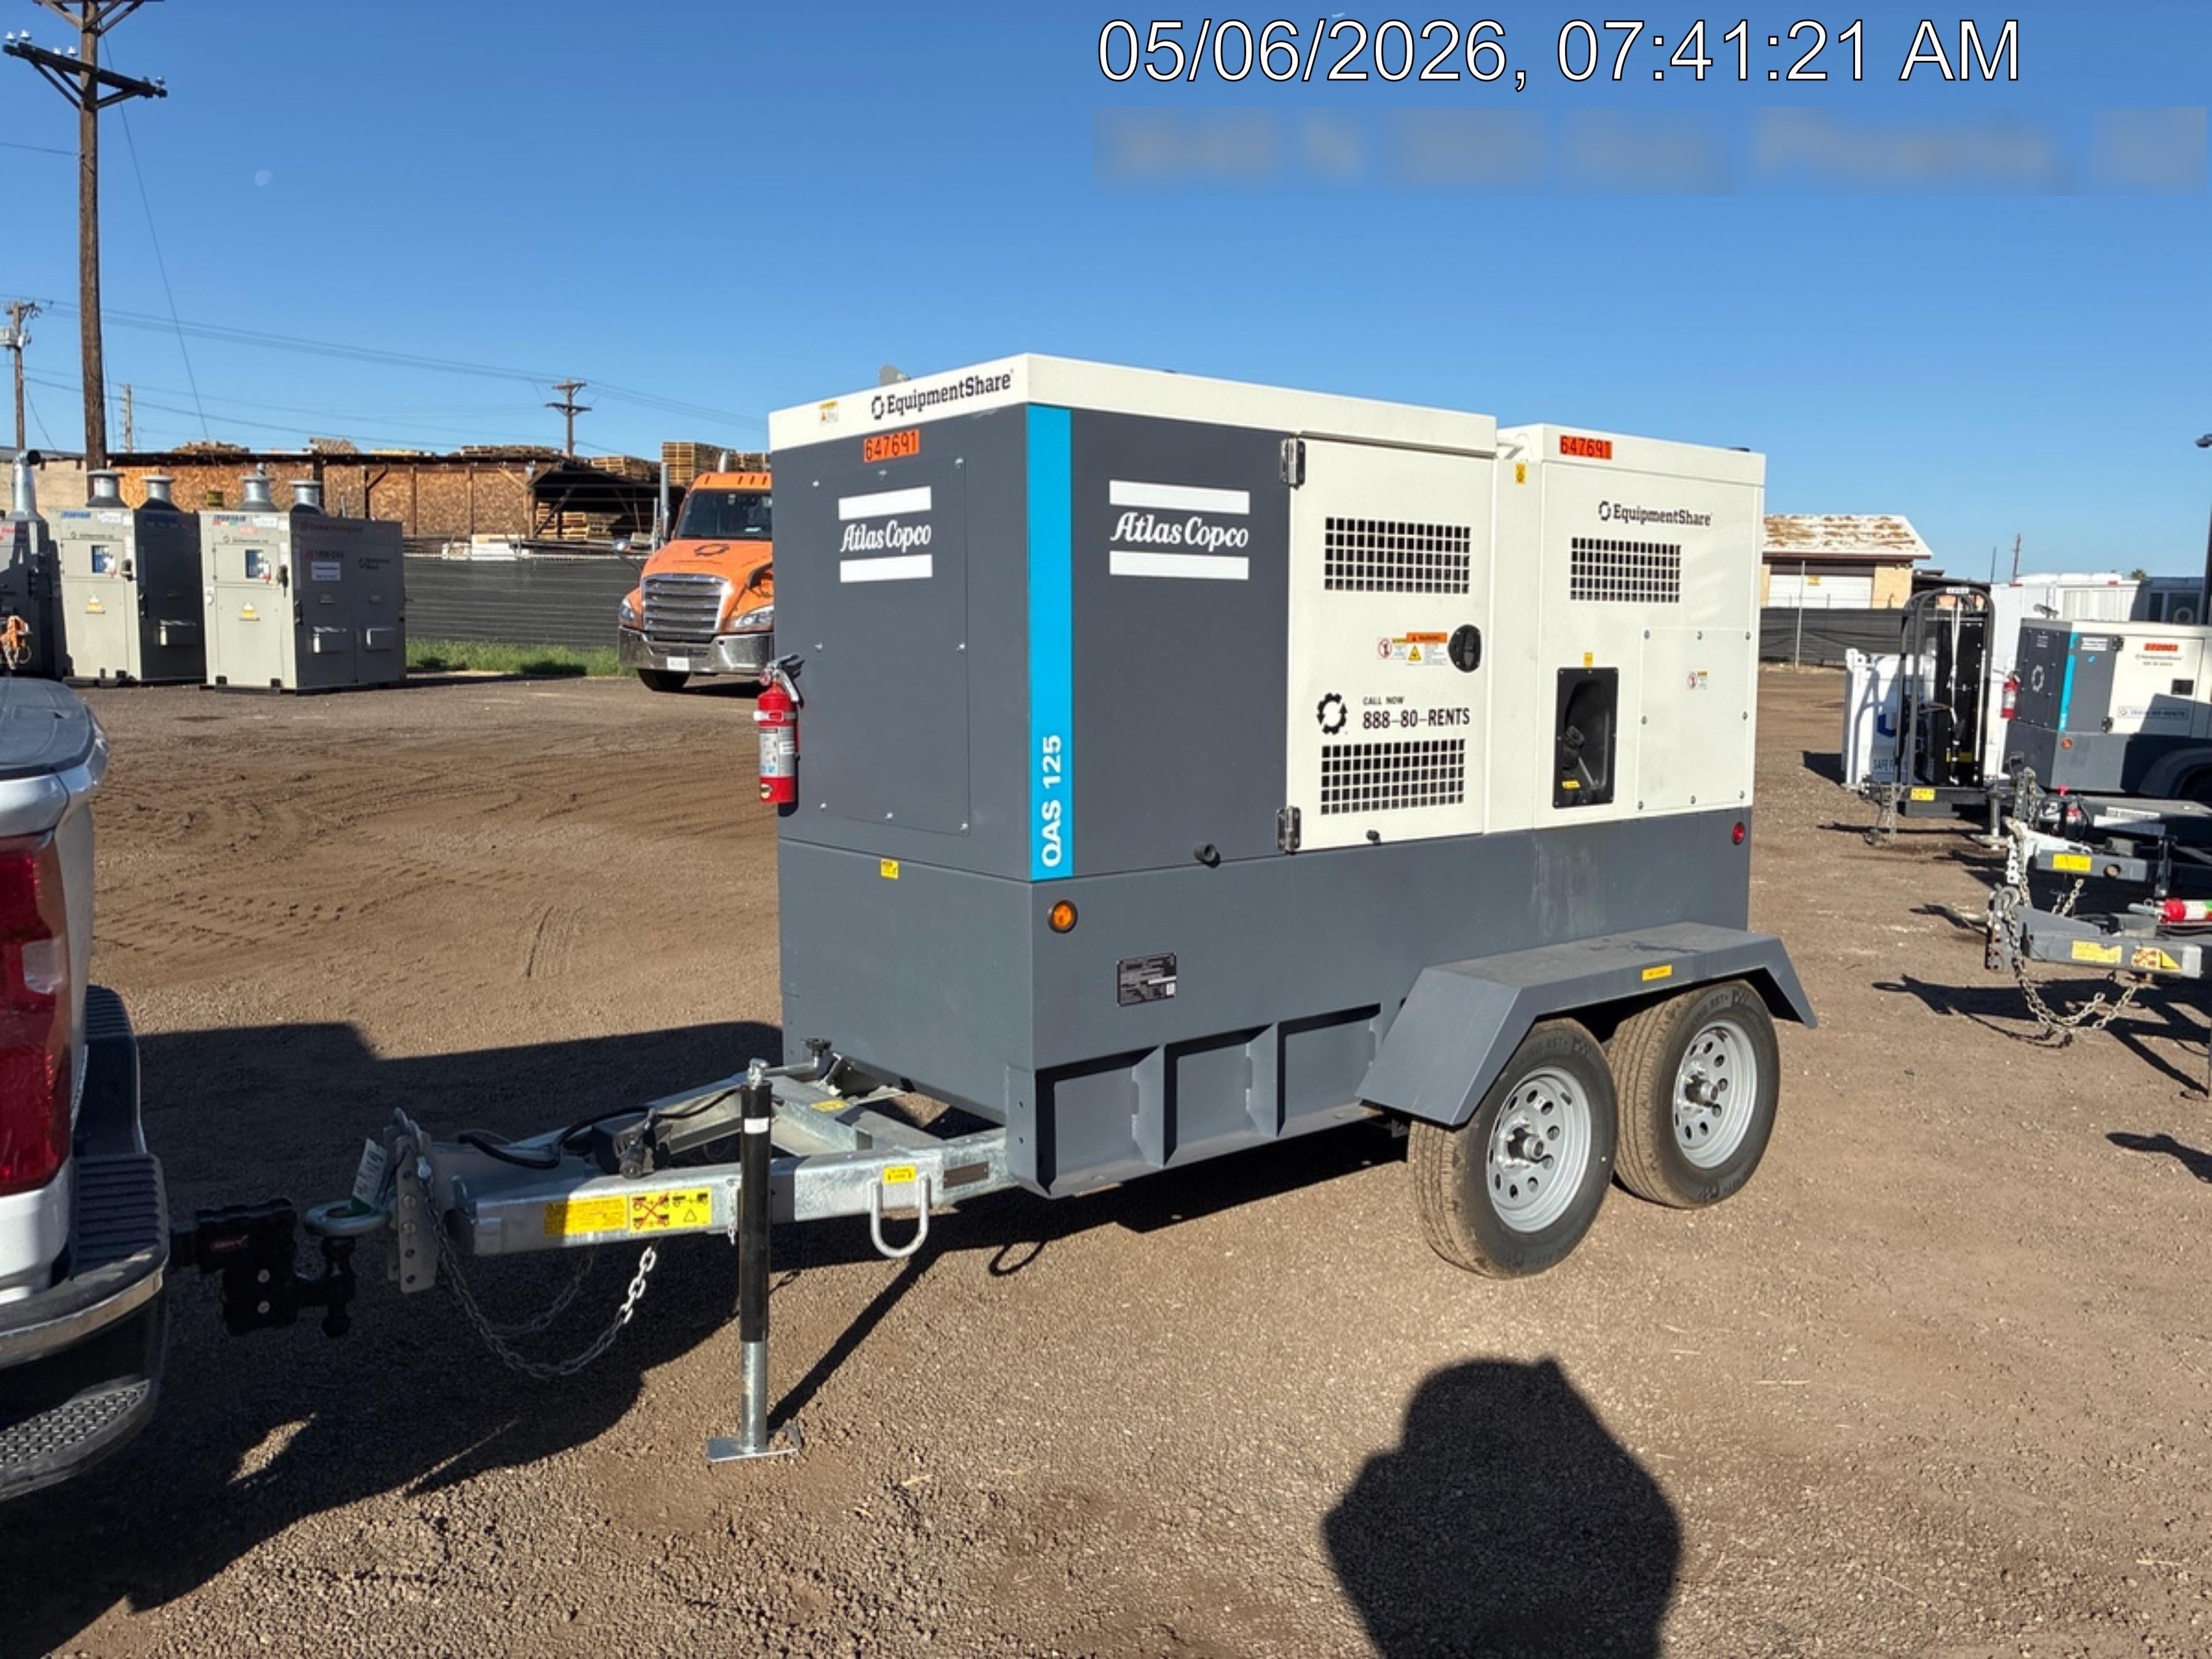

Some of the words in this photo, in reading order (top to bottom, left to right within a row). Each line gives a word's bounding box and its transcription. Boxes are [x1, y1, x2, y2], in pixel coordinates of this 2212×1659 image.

[886, 373, 1011, 416] EquipmentShare
[865, 431, 917, 461] 647691
[1559, 435, 1612, 459] 647691
[1613, 503, 1712, 527] EquipmentShare
[839, 523, 884, 552] Atlas
[885, 519, 931, 554] Copco
[1110, 511, 1182, 544] Atlas
[1184, 516, 1249, 552] Copco
[1362, 696, 1382, 706] CALL
[1386, 696, 1405, 705] NOW
[1042, 735, 1062, 790] 125
